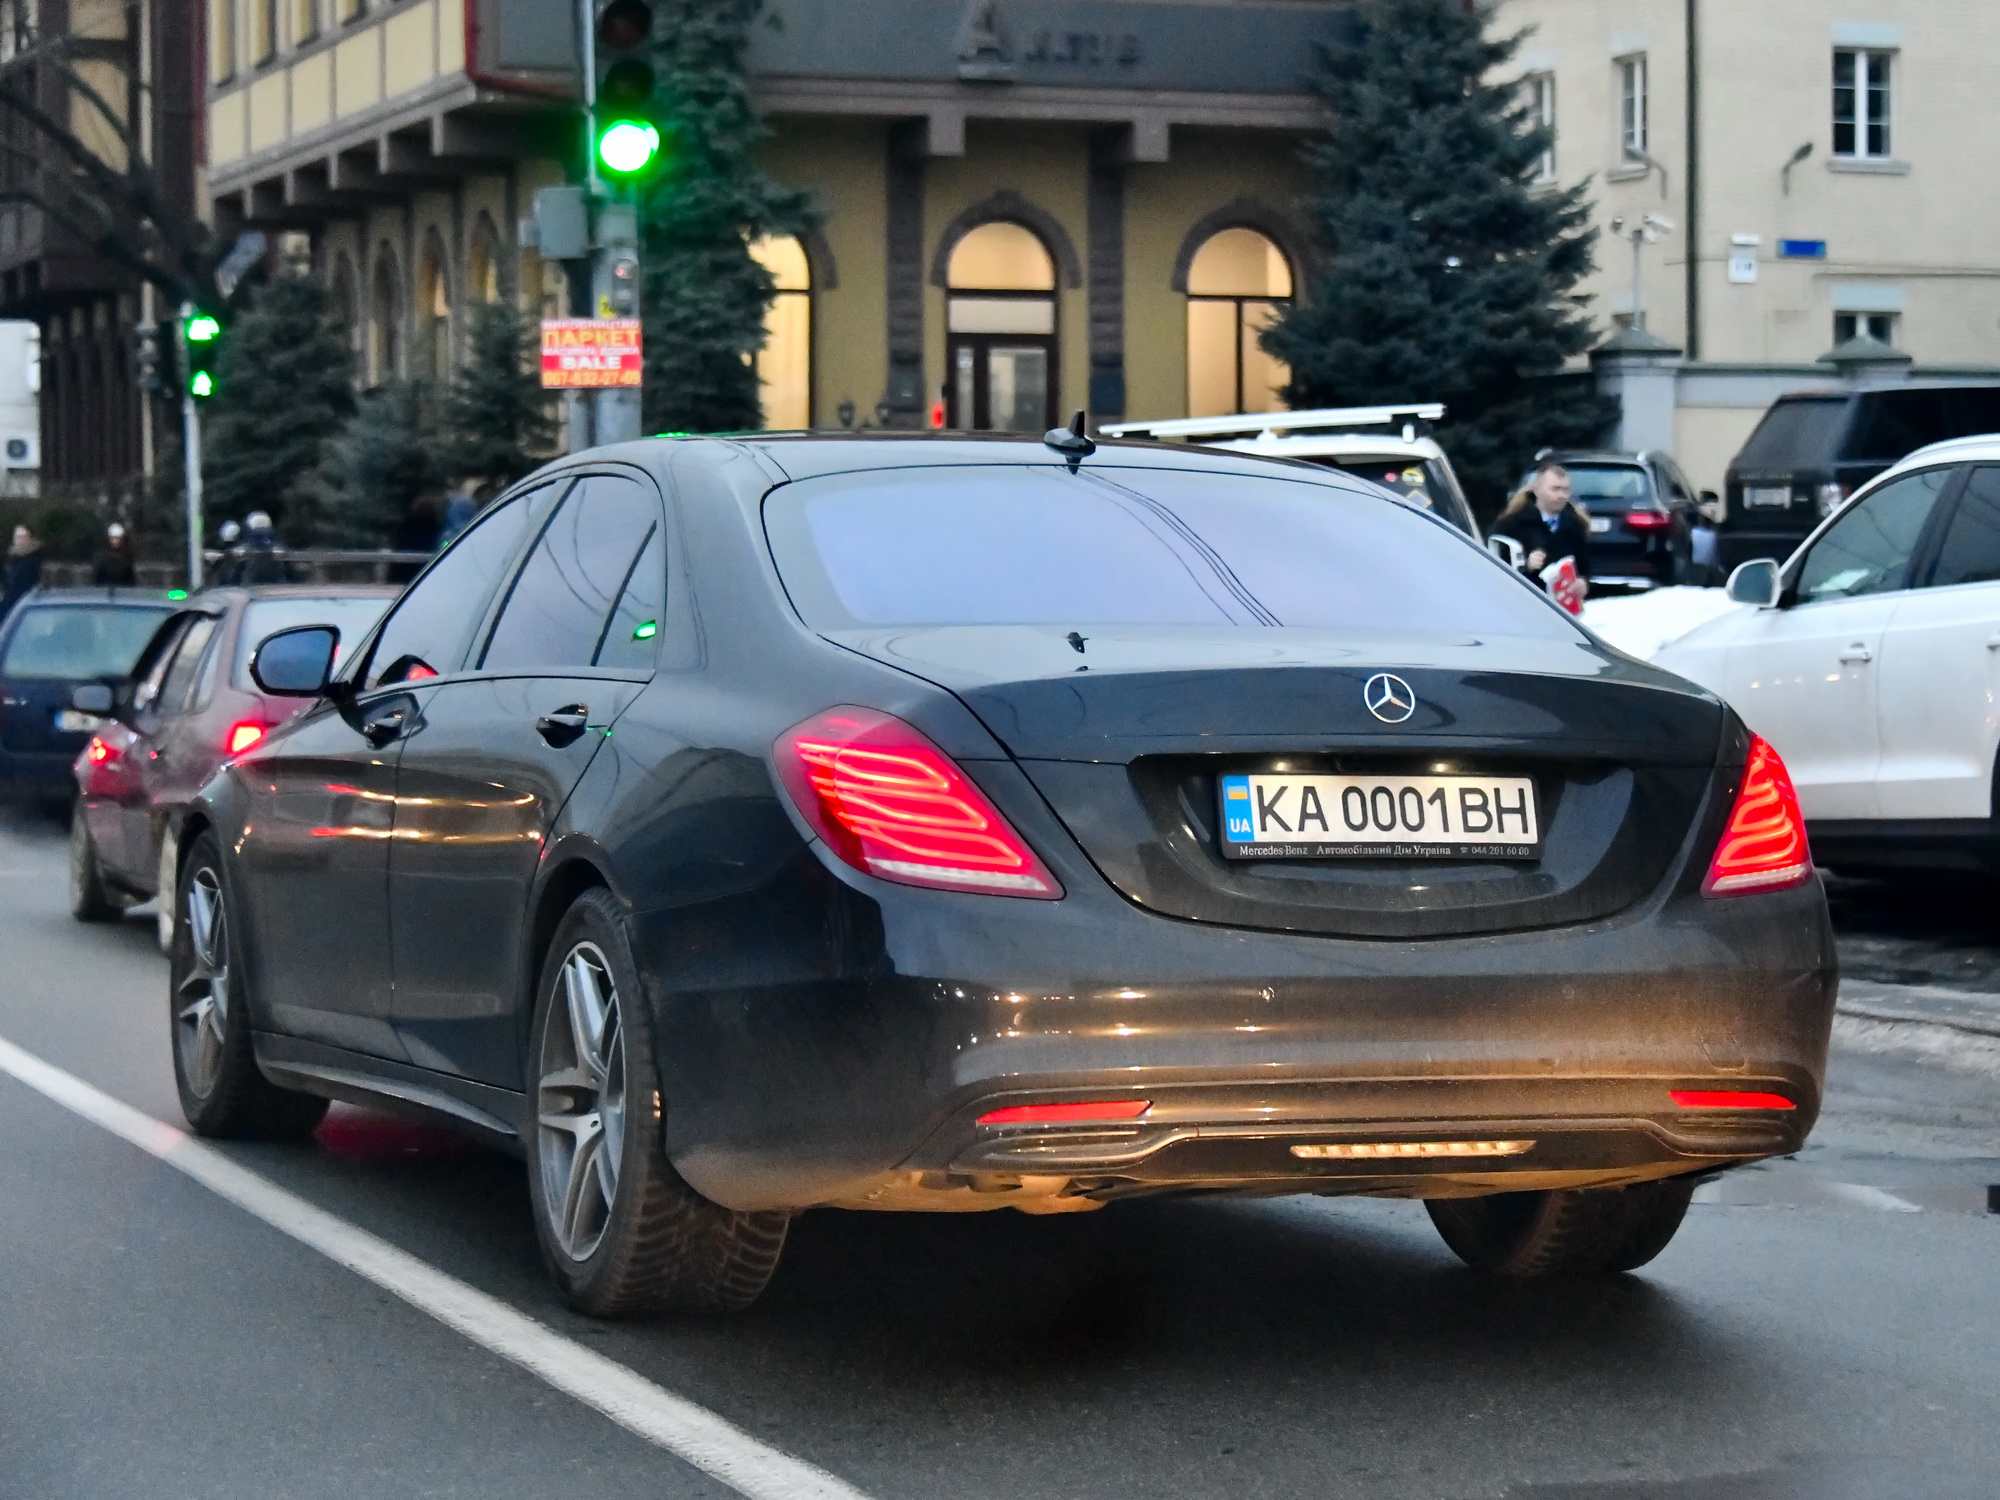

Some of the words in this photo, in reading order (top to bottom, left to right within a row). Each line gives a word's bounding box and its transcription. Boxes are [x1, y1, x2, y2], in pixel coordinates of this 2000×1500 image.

[545, 329, 638, 347] ПАРКЕТ
[562, 356, 621, 369] SALE
[1256, 785, 1329, 832] KA
[1230, 818, 1251, 833] UA
[1239, 846, 1308, 856] Mercedes-Benz
[1316, 845, 1391, 856] Автомобільний
[1393, 845, 1412, 856] Дім
[1413, 845, 1451, 857] Україна
